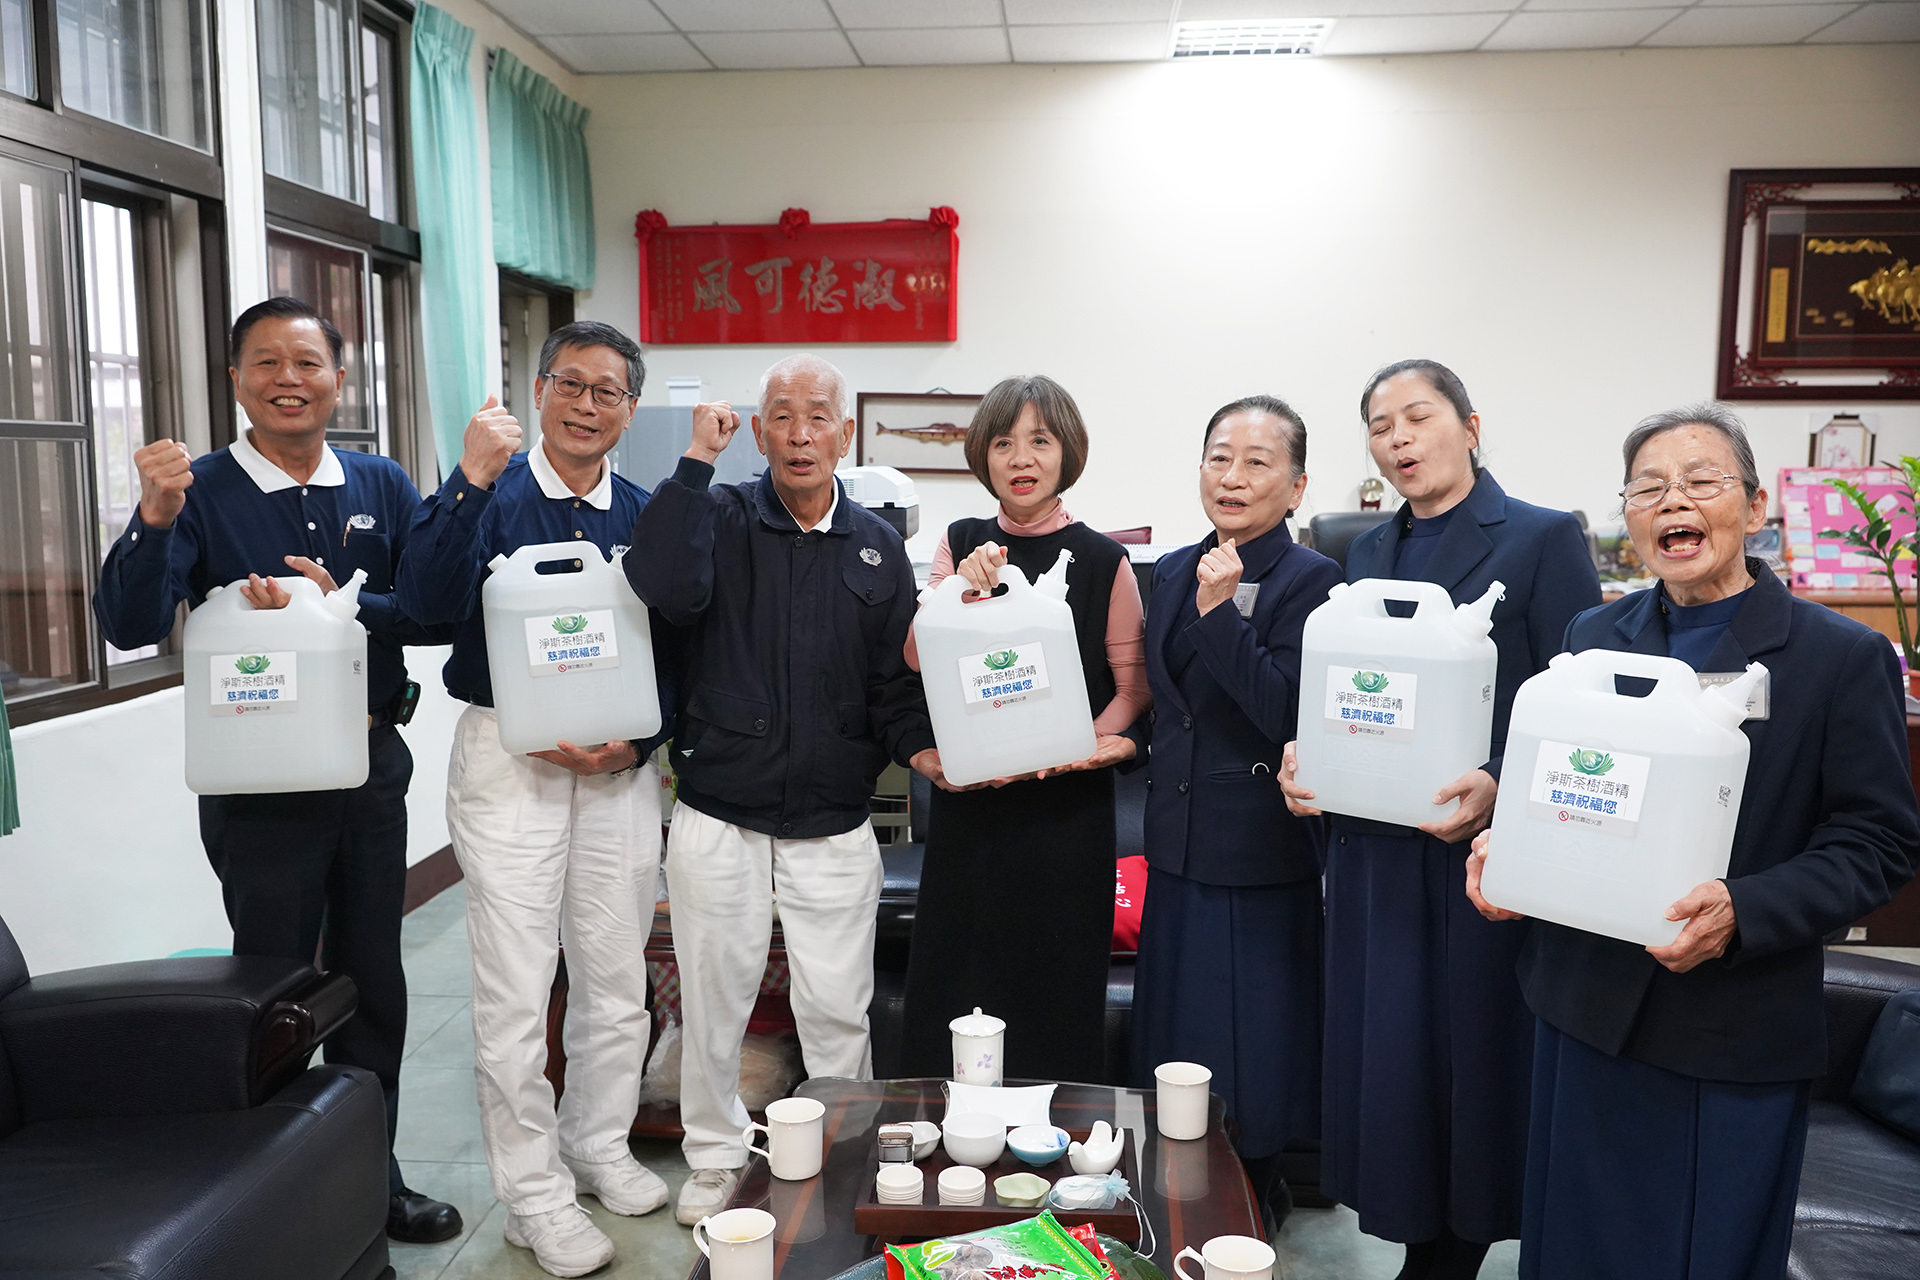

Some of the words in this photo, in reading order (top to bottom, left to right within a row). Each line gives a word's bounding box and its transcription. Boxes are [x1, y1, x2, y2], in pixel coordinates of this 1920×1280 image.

[538, 632, 605, 649] 淨斯茶樹酒精
[547, 646, 601, 661] 慈濟祝福您
[220, 674, 285, 688] 淨斯茶樹酒精
[973, 665, 1037, 687] 淨斯茶樹酒精
[227, 688, 279, 701] 慈濟祝福您
[981, 679, 1034, 698] 慈濟祝福您
[1335, 691, 1403, 711] 淨斯茶樹酒精
[1340, 707, 1395, 725] 慈濟祝福您
[1545, 770, 1630, 799] 淨斯茶樹酒精
[1550, 789, 1618, 814] 慈濟祝福您
